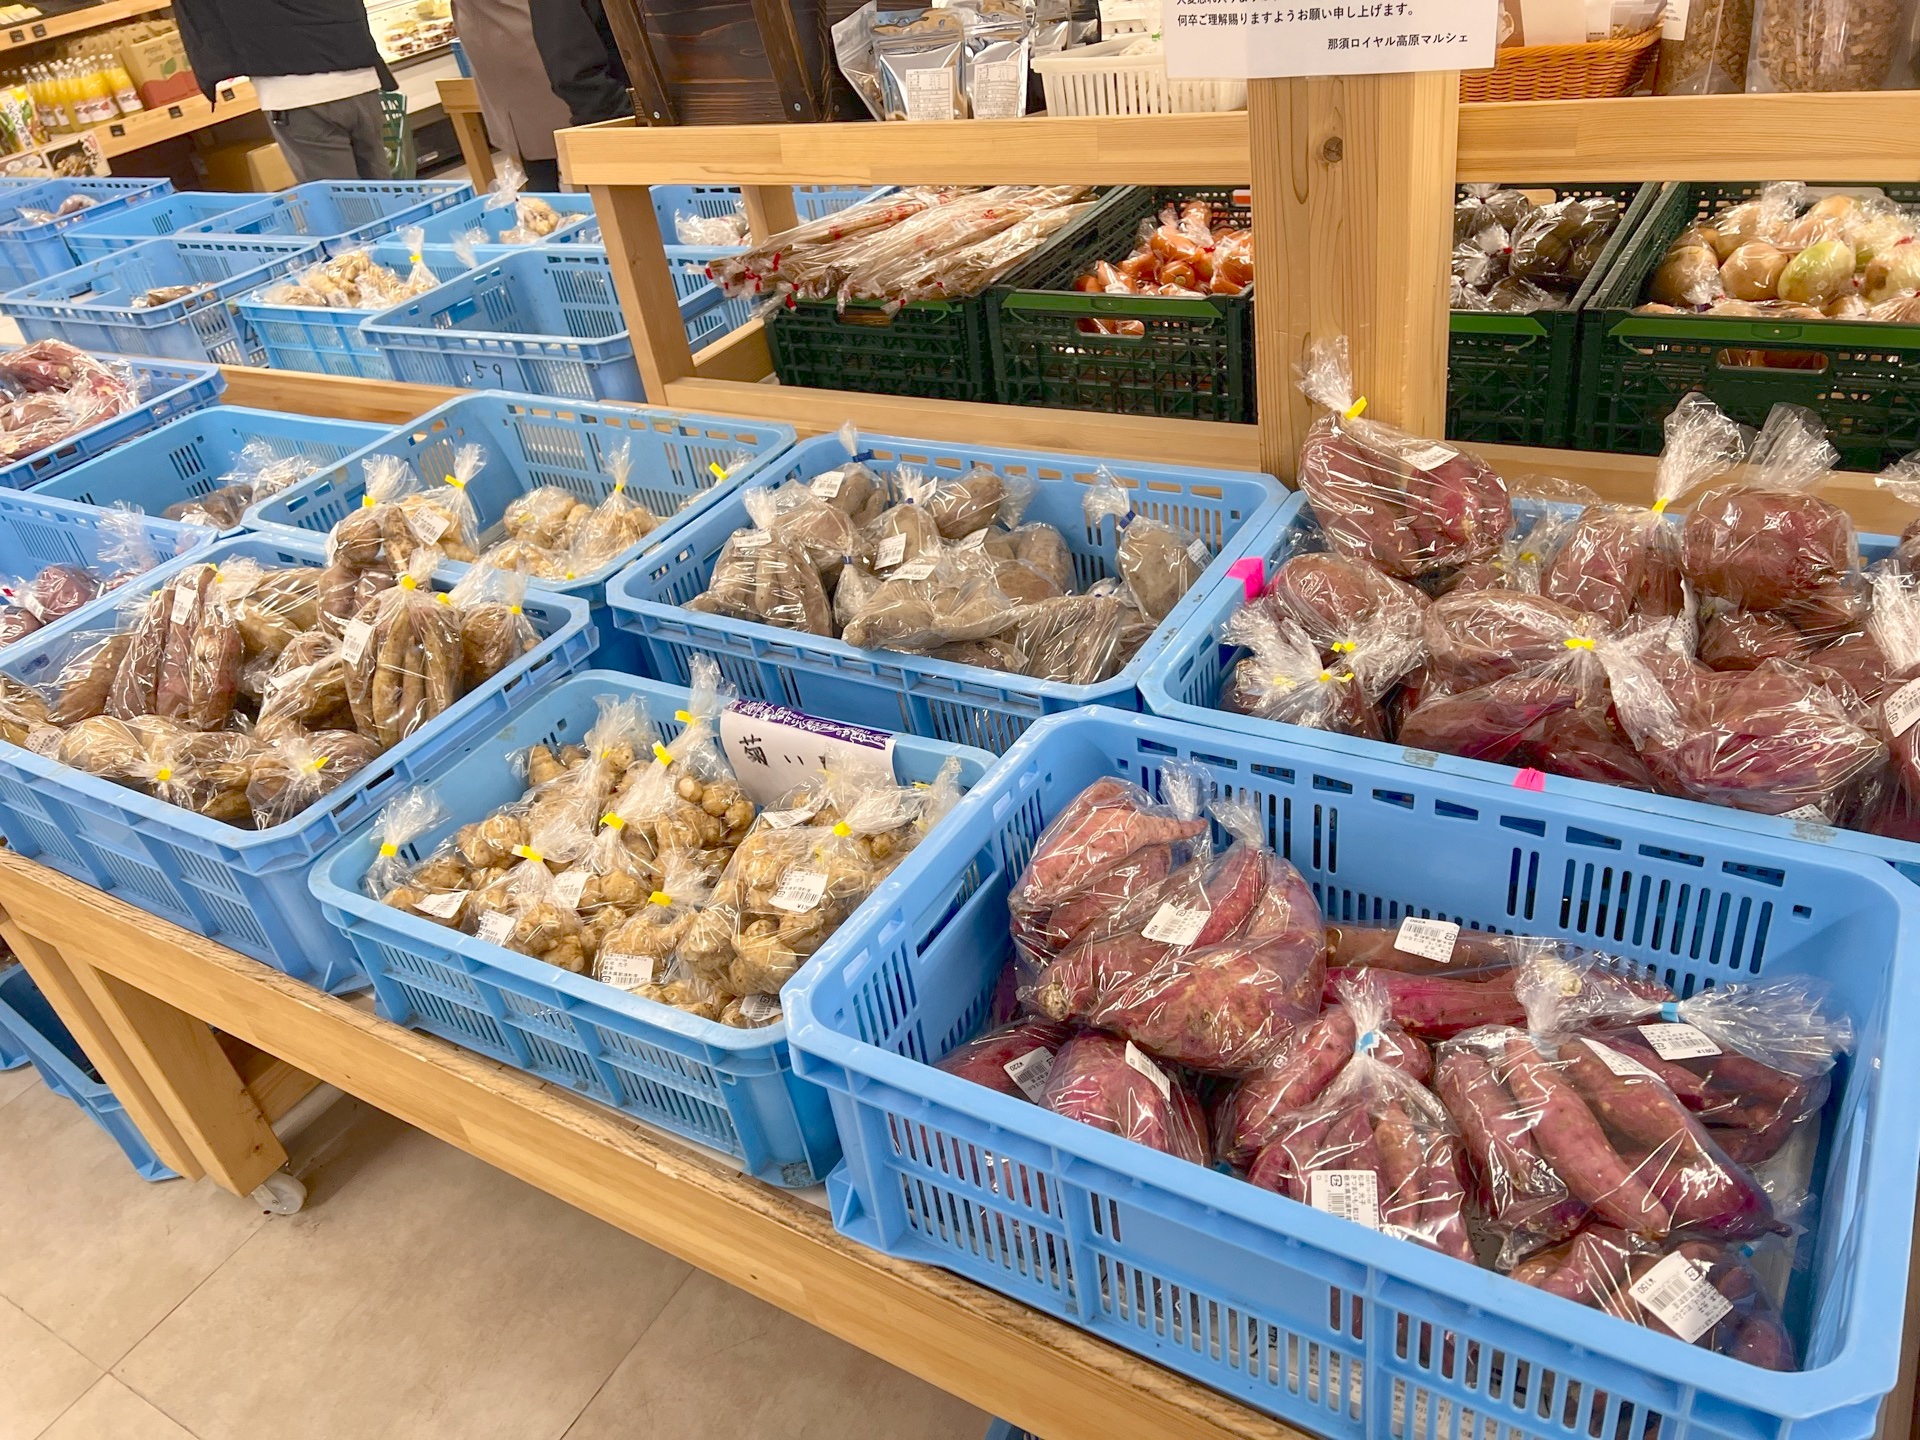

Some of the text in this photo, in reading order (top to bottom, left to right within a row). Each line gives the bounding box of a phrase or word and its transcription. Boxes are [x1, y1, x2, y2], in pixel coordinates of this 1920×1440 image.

[1177, 4, 1413, 27] 何卒ご理解賜りますようお願い申し上げます。
[1327, 32, 1468, 51] 那須ロイヤル高原マルシェ
[739, 733, 828, 771] 菊い
[1009, 1062, 1024, 1071] ¥220
[1637, 1278, 1656, 1294] ¥150
